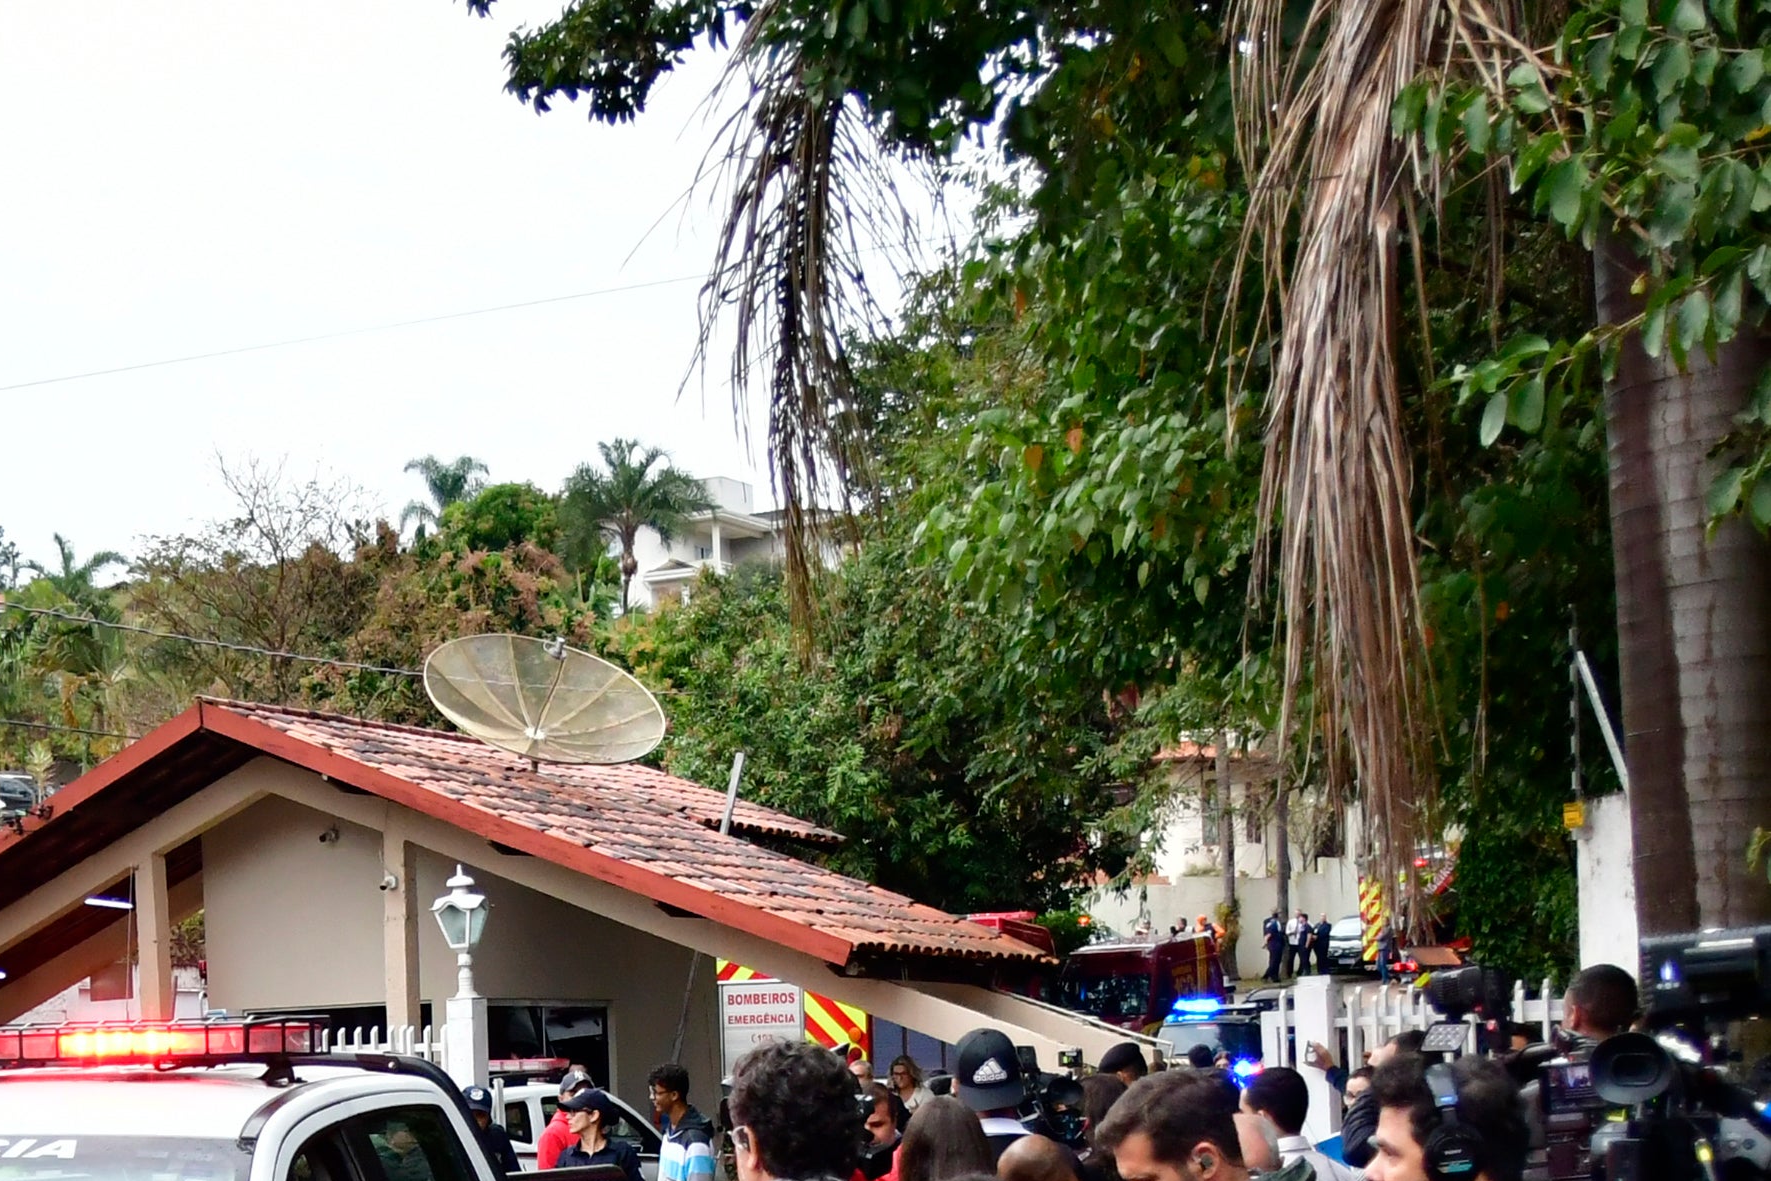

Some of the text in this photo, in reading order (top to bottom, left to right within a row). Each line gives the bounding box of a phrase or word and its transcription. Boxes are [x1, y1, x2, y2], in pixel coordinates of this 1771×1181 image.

[727, 992, 795, 1006] BOMBEIROS
[727, 1011, 795, 1025] EMERGÊNCIA
[974, 1071, 1006, 1082] adidas
